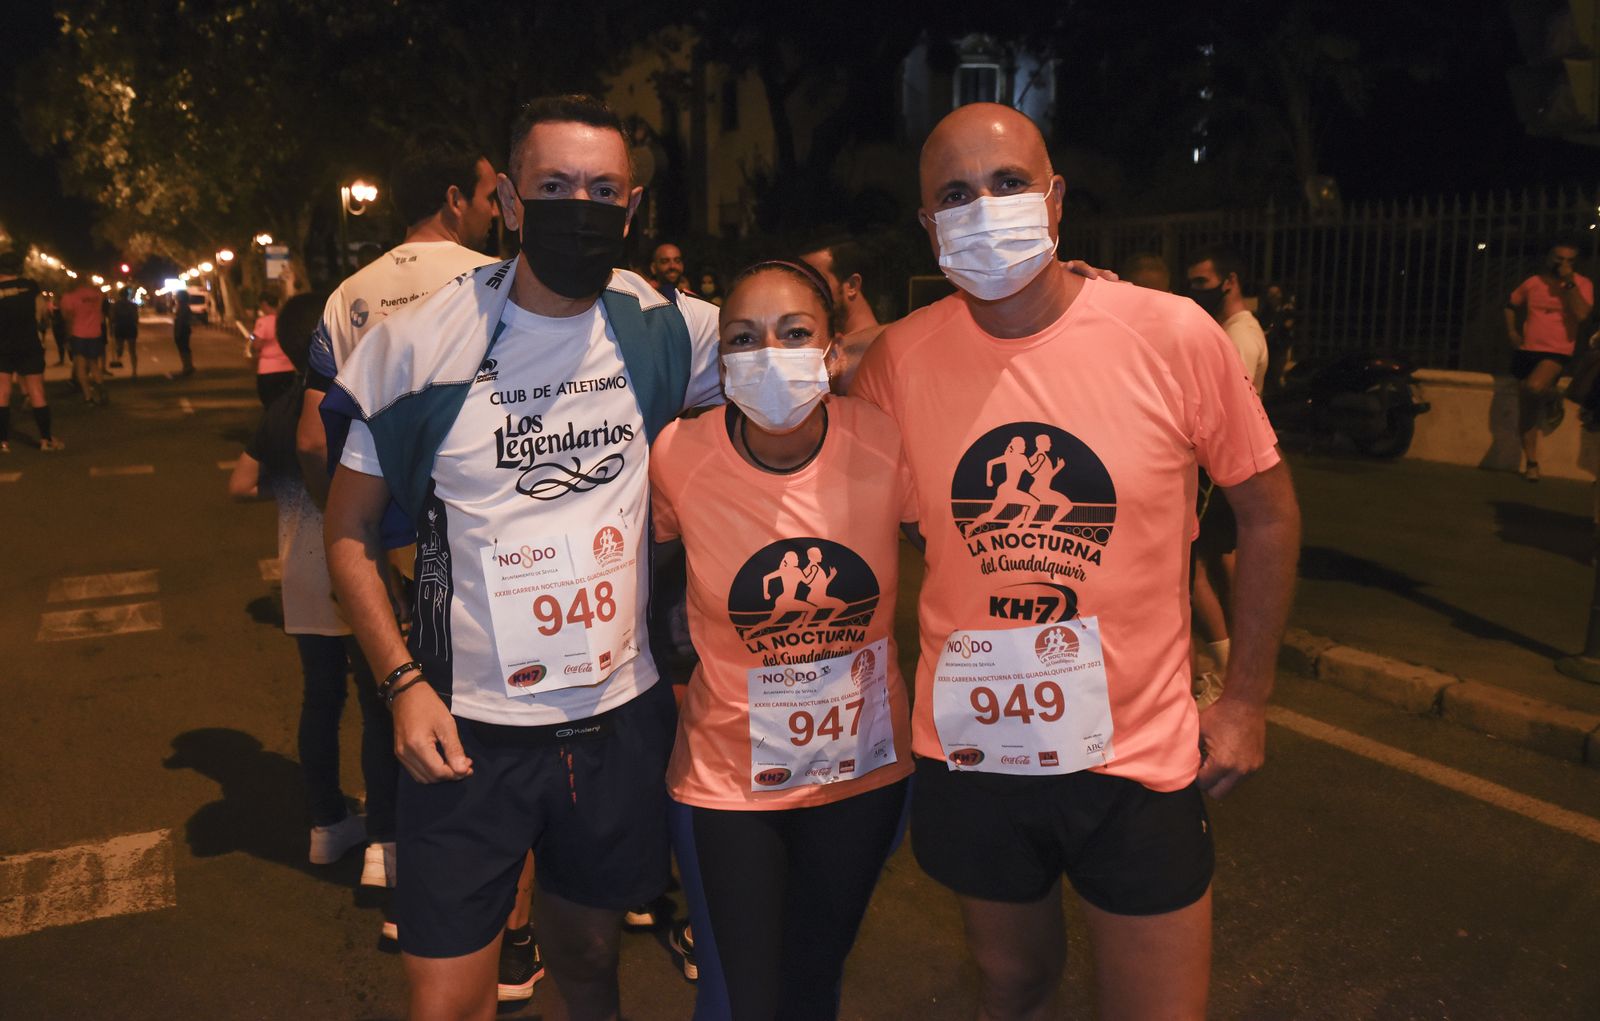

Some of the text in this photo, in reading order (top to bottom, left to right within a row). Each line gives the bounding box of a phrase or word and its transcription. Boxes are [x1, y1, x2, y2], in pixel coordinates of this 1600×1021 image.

[380, 296, 408, 307] Puerto
[489, 375, 627, 406] CLUB DE ATLETISMO
[493, 413, 634, 471] Los Legendarios
[966, 533, 1101, 566] LA NOCTURNA
[980, 554, 1087, 582] del Guadalquivir
[512, 585, 540, 595] CARRERA
[540, 580, 575, 590] NOCTURNA
[575, 577, 586, 585] DEL
[532, 580, 617, 637] 948
[746, 629, 866, 654] LA NOCTURNA
[762, 654, 781, 667] del
[951, 675, 977, 683] CARRERA
[977, 673, 1012, 682] NOCTURNA
[1012, 672, 1025, 680] DEL
[1025, 666, 1073, 679] GUADALQUIVIR
[1087, 660, 1102, 669] 2021
[771, 700, 798, 708] CARRERA
[798, 698, 830, 708] NOCTURNA
[970, 681, 1066, 725] 949
[788, 698, 865, 748] 947
